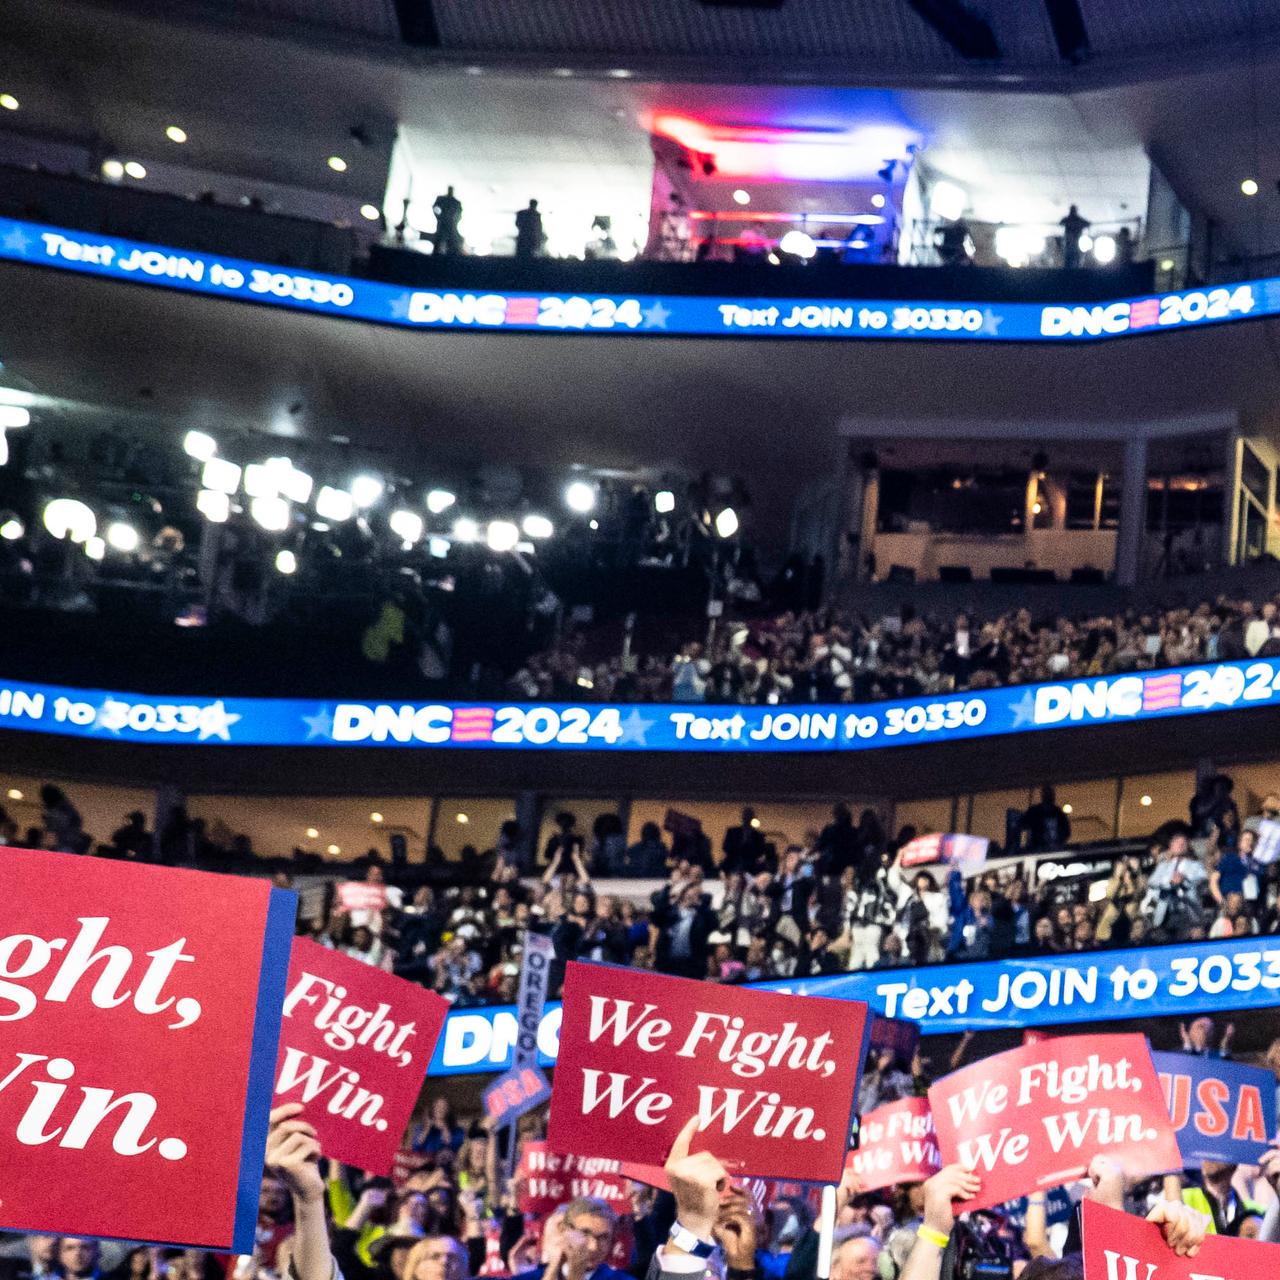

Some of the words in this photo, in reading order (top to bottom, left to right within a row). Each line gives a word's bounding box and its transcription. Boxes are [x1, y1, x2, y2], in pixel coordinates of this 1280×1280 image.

[41, 232, 115, 267] Text
[119, 249, 202, 284] JOIN
[209, 264, 245, 289] to
[248, 269, 354, 307] 30330
[408, 290, 506, 326] DNC
[537, 293, 644, 330] 2024
[718, 304, 781, 328] Text
[782, 304, 853, 329] JOIN
[856, 305, 887, 330] to
[1040, 300, 1131, 337] DNC
[1158, 285, 1255, 325] 2024
[53, 696, 95, 726] to
[332, 703, 454, 744] DNC
[491, 708, 624, 744] 2024
[670, 711, 749, 741] Text
[750, 710, 837, 741] JOIN
[845, 712, 878, 740] to
[883, 698, 986, 737] 30330
[1033, 678, 1143, 725] DNC
[283, 970, 417, 1068] Fight,
[517, 951, 546, 1064] OREGO
[877, 977, 974, 1020] Text
[980, 966, 1098, 1014] JOIN
[1109, 963, 1155, 1001] to
[588, 994, 669, 1054] We
[676, 1010, 838, 1080] Fight,
[275, 1046, 390, 1133] Win.
[581, 1068, 673, 1126] We
[697, 1083, 827, 1142] Win.
[947, 1081, 1009, 1130] We
[1017, 1051, 1143, 1103] Fight,
[956, 1130, 1030, 1174] We
[1040, 1106, 1159, 1154] Win.
